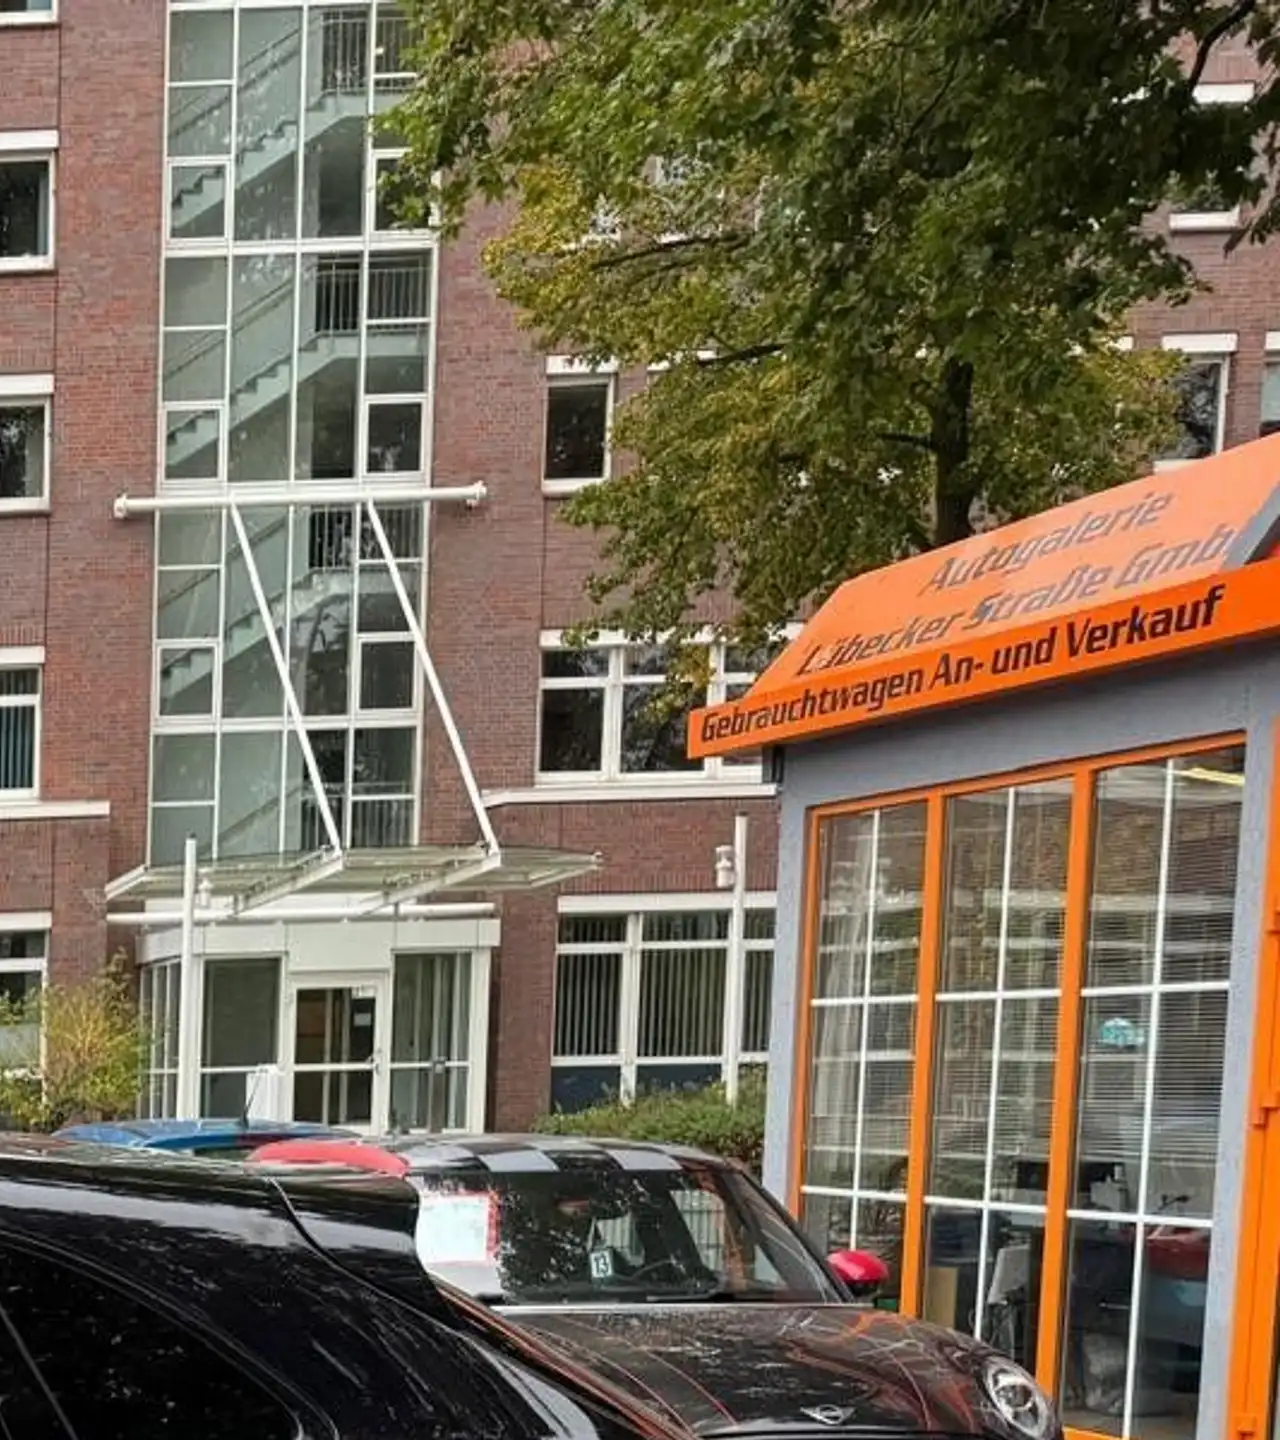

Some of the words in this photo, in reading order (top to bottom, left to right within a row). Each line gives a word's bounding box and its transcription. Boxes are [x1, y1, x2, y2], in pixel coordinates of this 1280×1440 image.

[796, 611, 966, 677] Lübecker
[962, 563, 1114, 632] Straße
[1114, 522, 1239, 590] Gmb
[918, 492, 1174, 597] Autogalerie
[700, 666, 924, 743] Gebrauchtwagen
[927, 652, 985, 692] An-
[990, 626, 1058, 677] und
[1066, 582, 1227, 659] Verkauf
